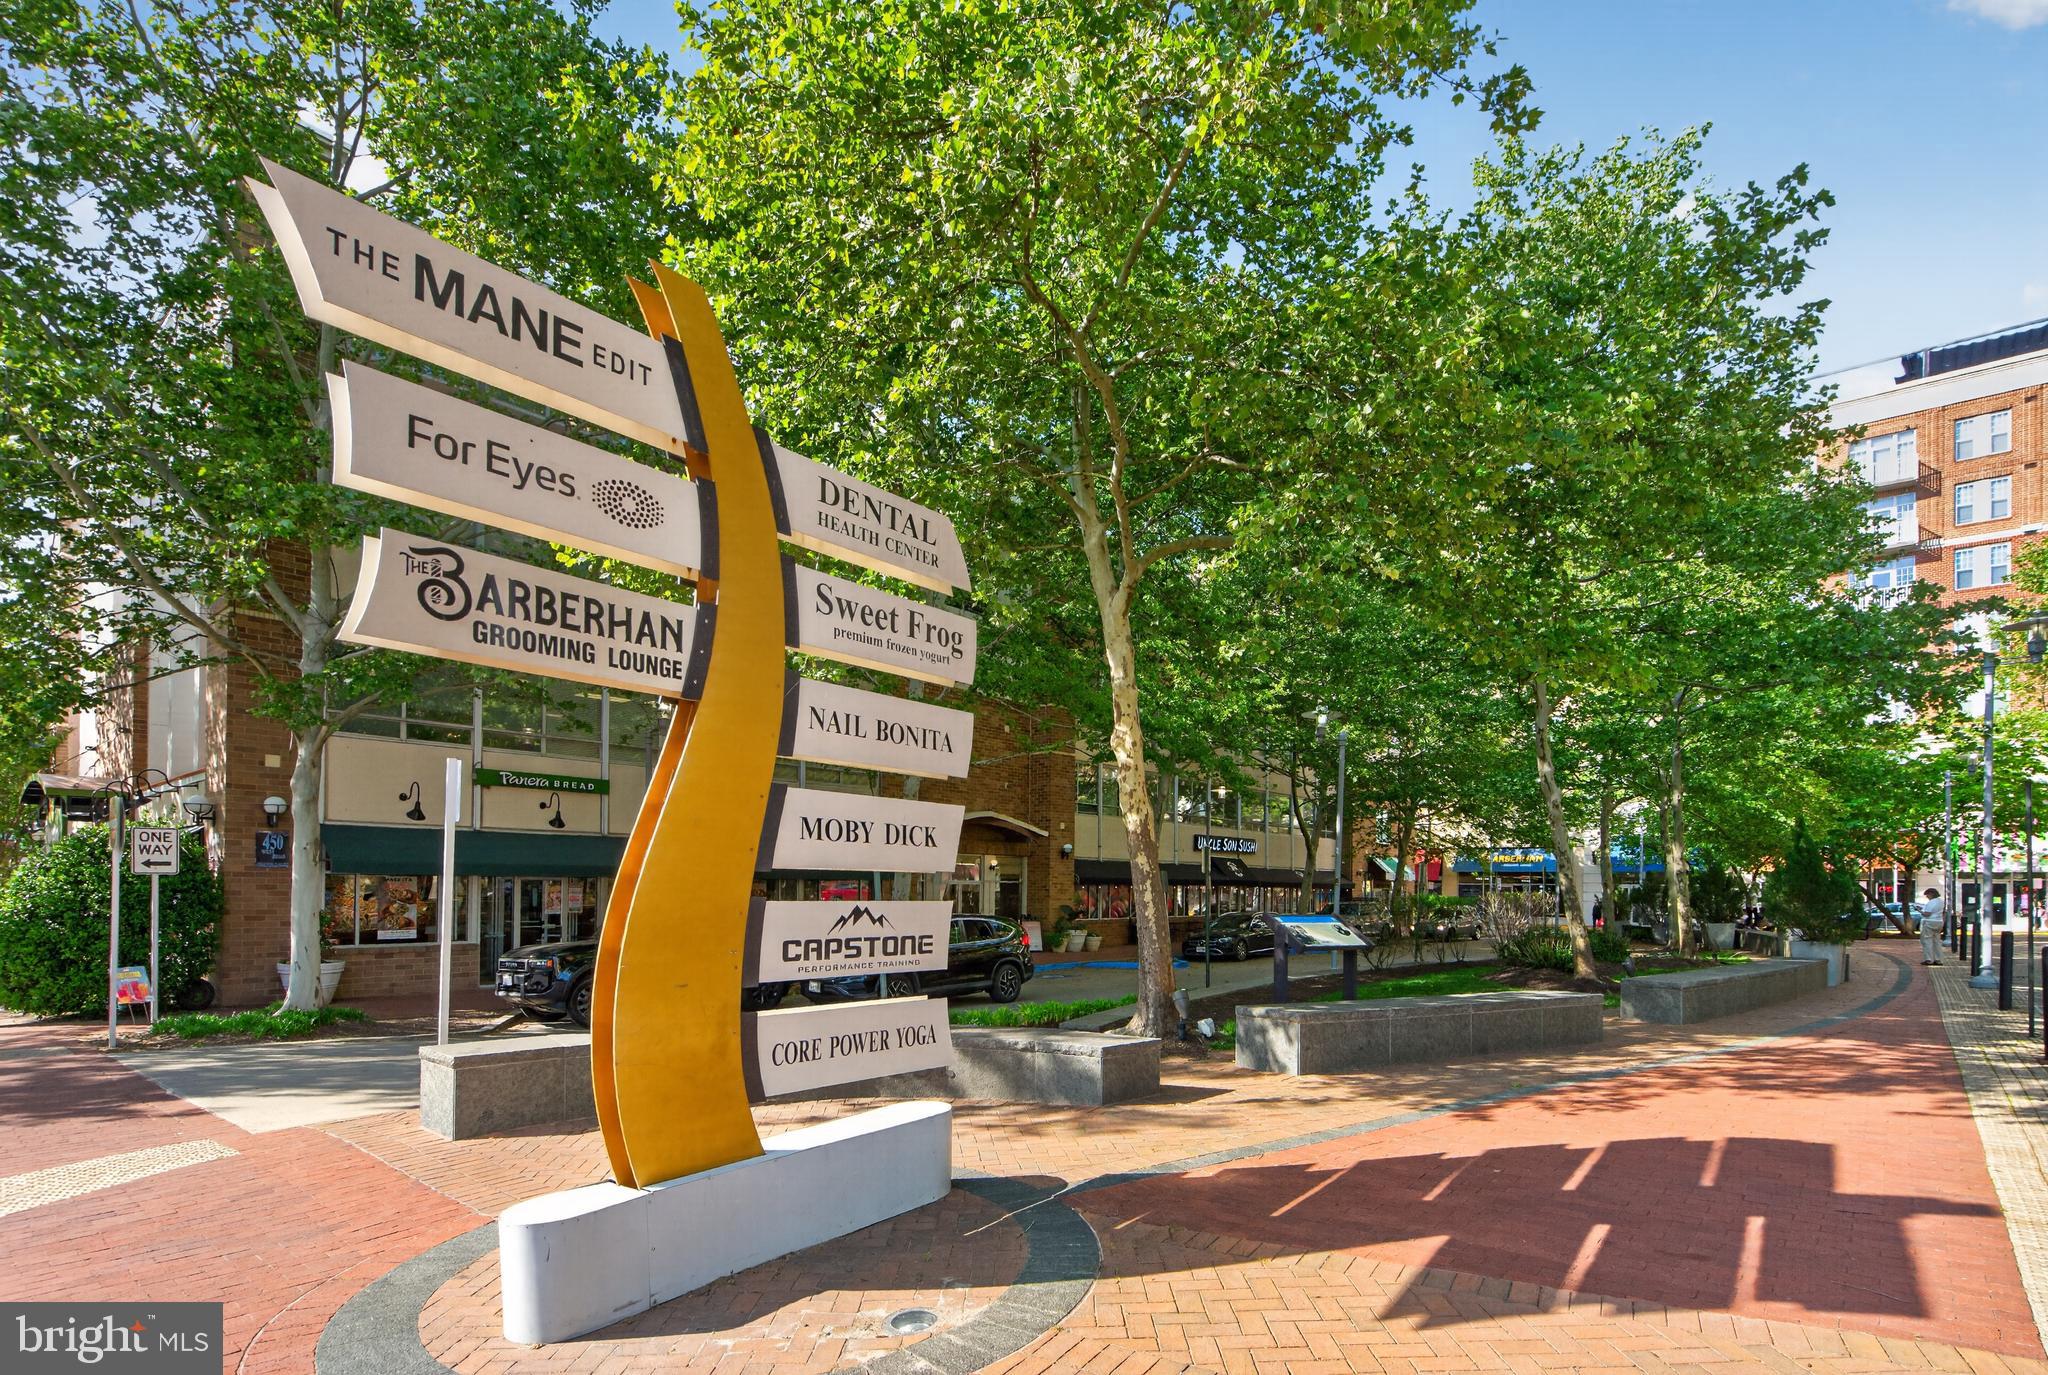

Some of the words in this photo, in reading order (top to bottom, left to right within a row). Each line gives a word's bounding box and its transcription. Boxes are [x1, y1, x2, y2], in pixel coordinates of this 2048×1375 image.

[326, 226, 400, 282] THE
[414, 253, 584, 368] MANE
[593, 343, 653, 386] EDIT
[407, 413, 476, 465] For
[817, 475, 938, 547] DENTAL
[817, 511, 880, 547] HEALTH
[885, 537, 940, 569] CENTER
[399, 551, 429, 576] THE
[815, 582, 900, 634] Sweet
[906, 608, 964, 660] Frog
[472, 620, 596, 664] GROOMING
[607, 647, 683, 681] LOUNGE
[833, 626, 883, 648] premium
[886, 638, 918, 657] frozen
[919, 649, 951, 665] yogurt
[808, 705, 868, 739] NAIL
[875, 718, 954, 754] BONITA
[499, 771, 549, 787] Panera
[553, 780, 595, 791] BREAD
[139, 831, 173, 843] ONE
[262, 832, 284, 850] 450
[799, 816, 875, 844] MOBY
[884, 822, 938, 848] DICK
[1238, 839, 1258, 853] SUSHI
[138, 844, 173, 856] WAY
[781, 934, 934, 963] CAPSTONE
[797, 962, 874, 973] PERFORMANCE
[877, 959, 921, 968] TRAINING
[771, 1038, 822, 1067] CORE
[829, 1030, 890, 1059] POWER
[896, 1024, 937, 1049] YOGA
